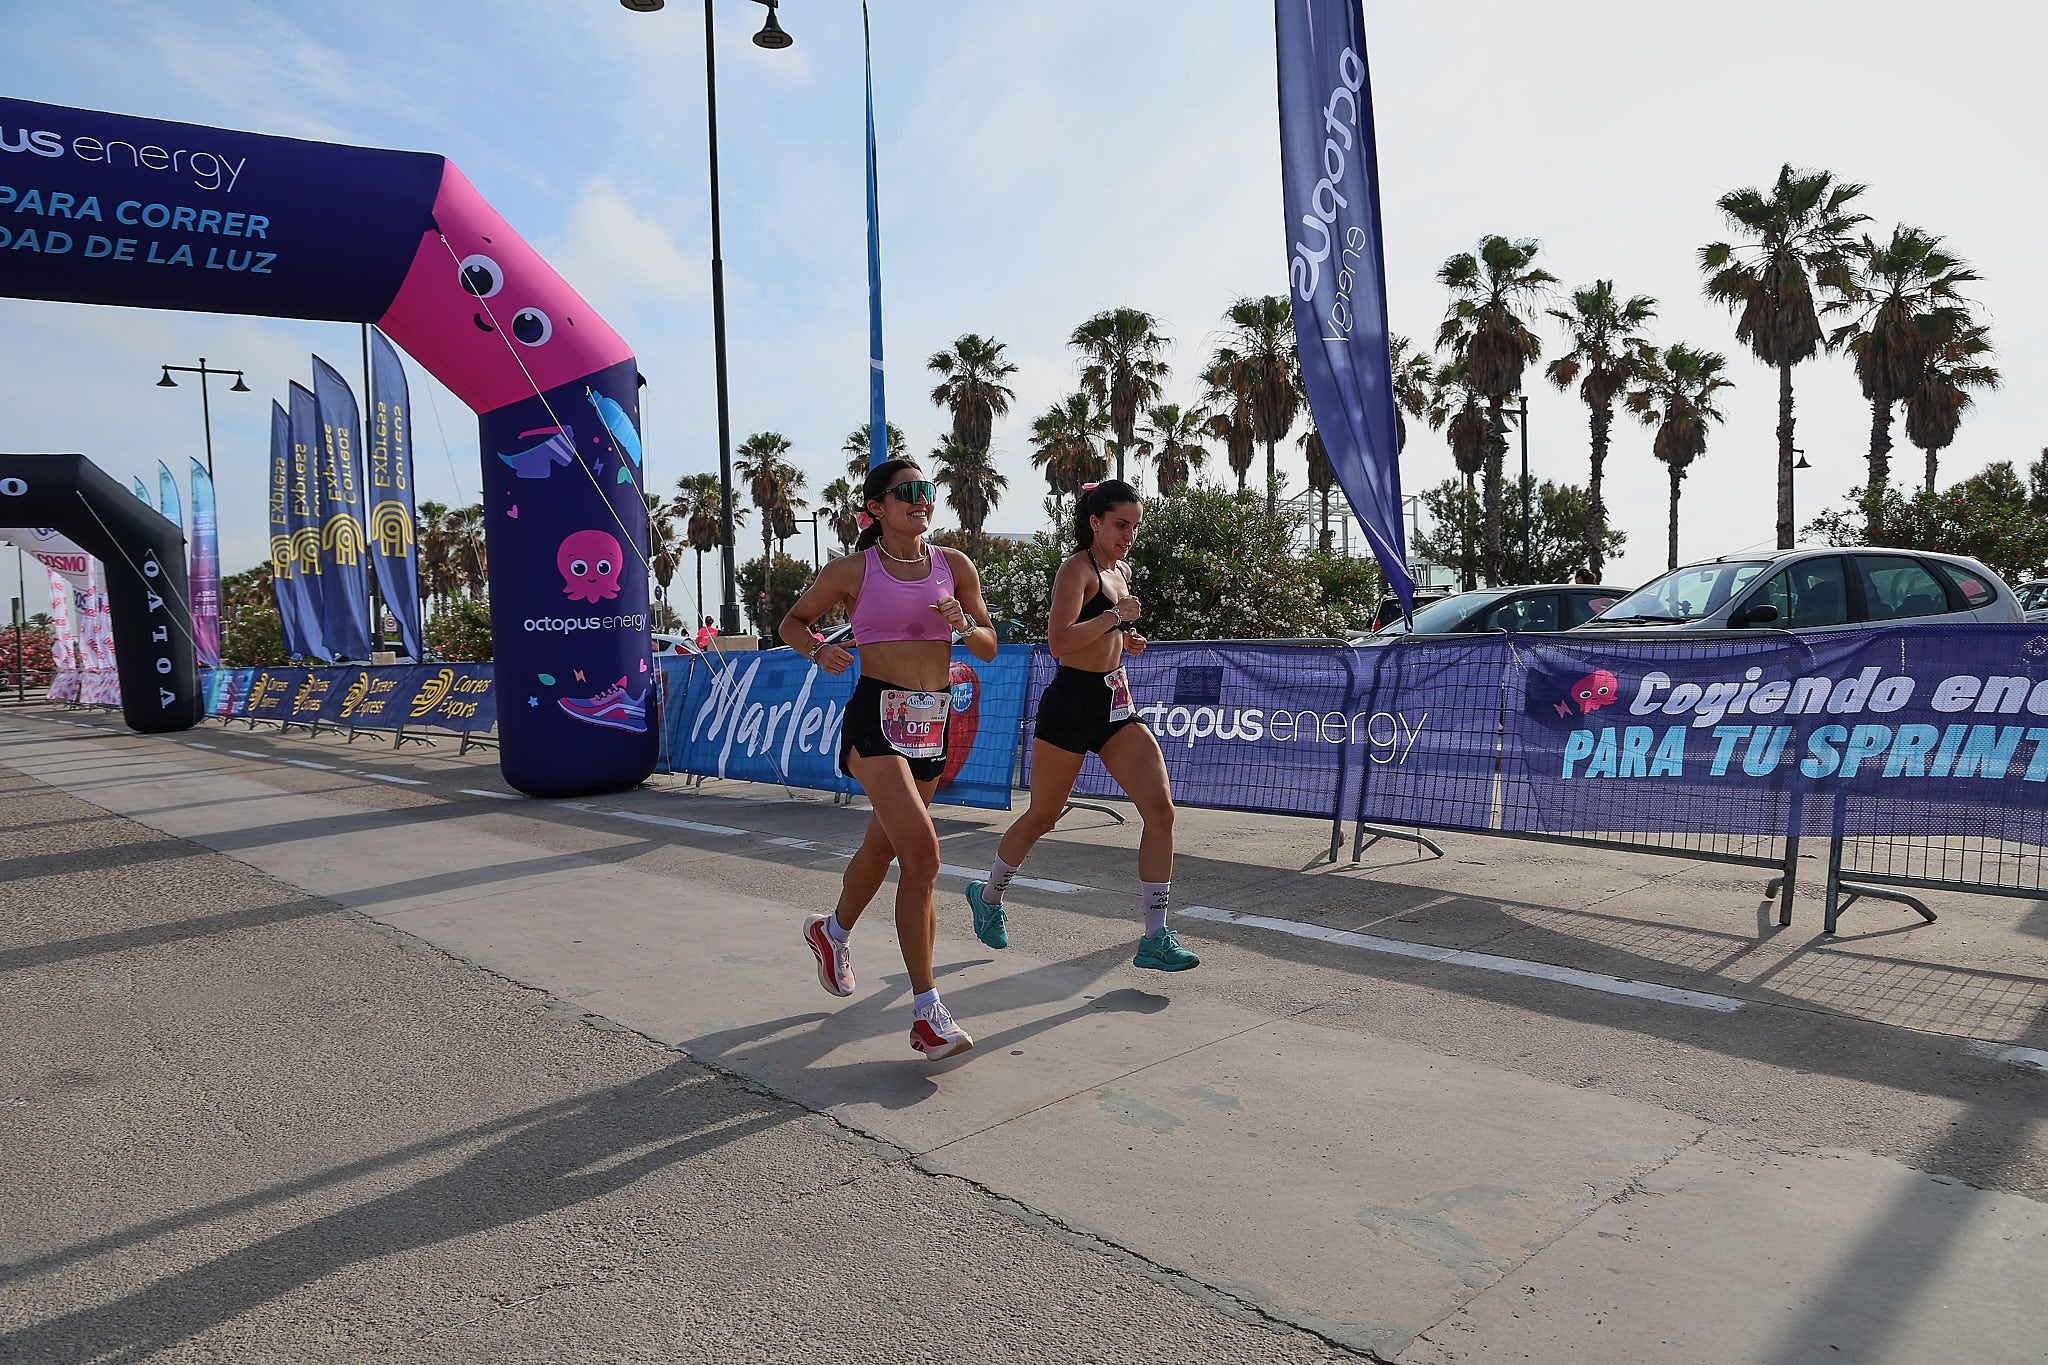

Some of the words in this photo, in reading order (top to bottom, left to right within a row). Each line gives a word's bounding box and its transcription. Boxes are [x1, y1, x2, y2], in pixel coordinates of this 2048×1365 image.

[73, 136, 246, 192] energy
[116, 200, 270, 240] CORRER
[84, 234, 138, 261] DE
[147, 241, 194, 267] LA
[206, 247, 278, 274] LUZ
[143, 560, 176, 709] VOLVO
[523, 616, 601, 635] octopus
[602, 613, 647, 632] energy
[1629, 666, 1916, 728] Cogiendo
[1270, 710, 1428, 765] energy
[1562, 725, 1687, 779] PARA
[1710, 725, 1793, 777] TU
[1800, 723, 2048, 783] SPRINT
